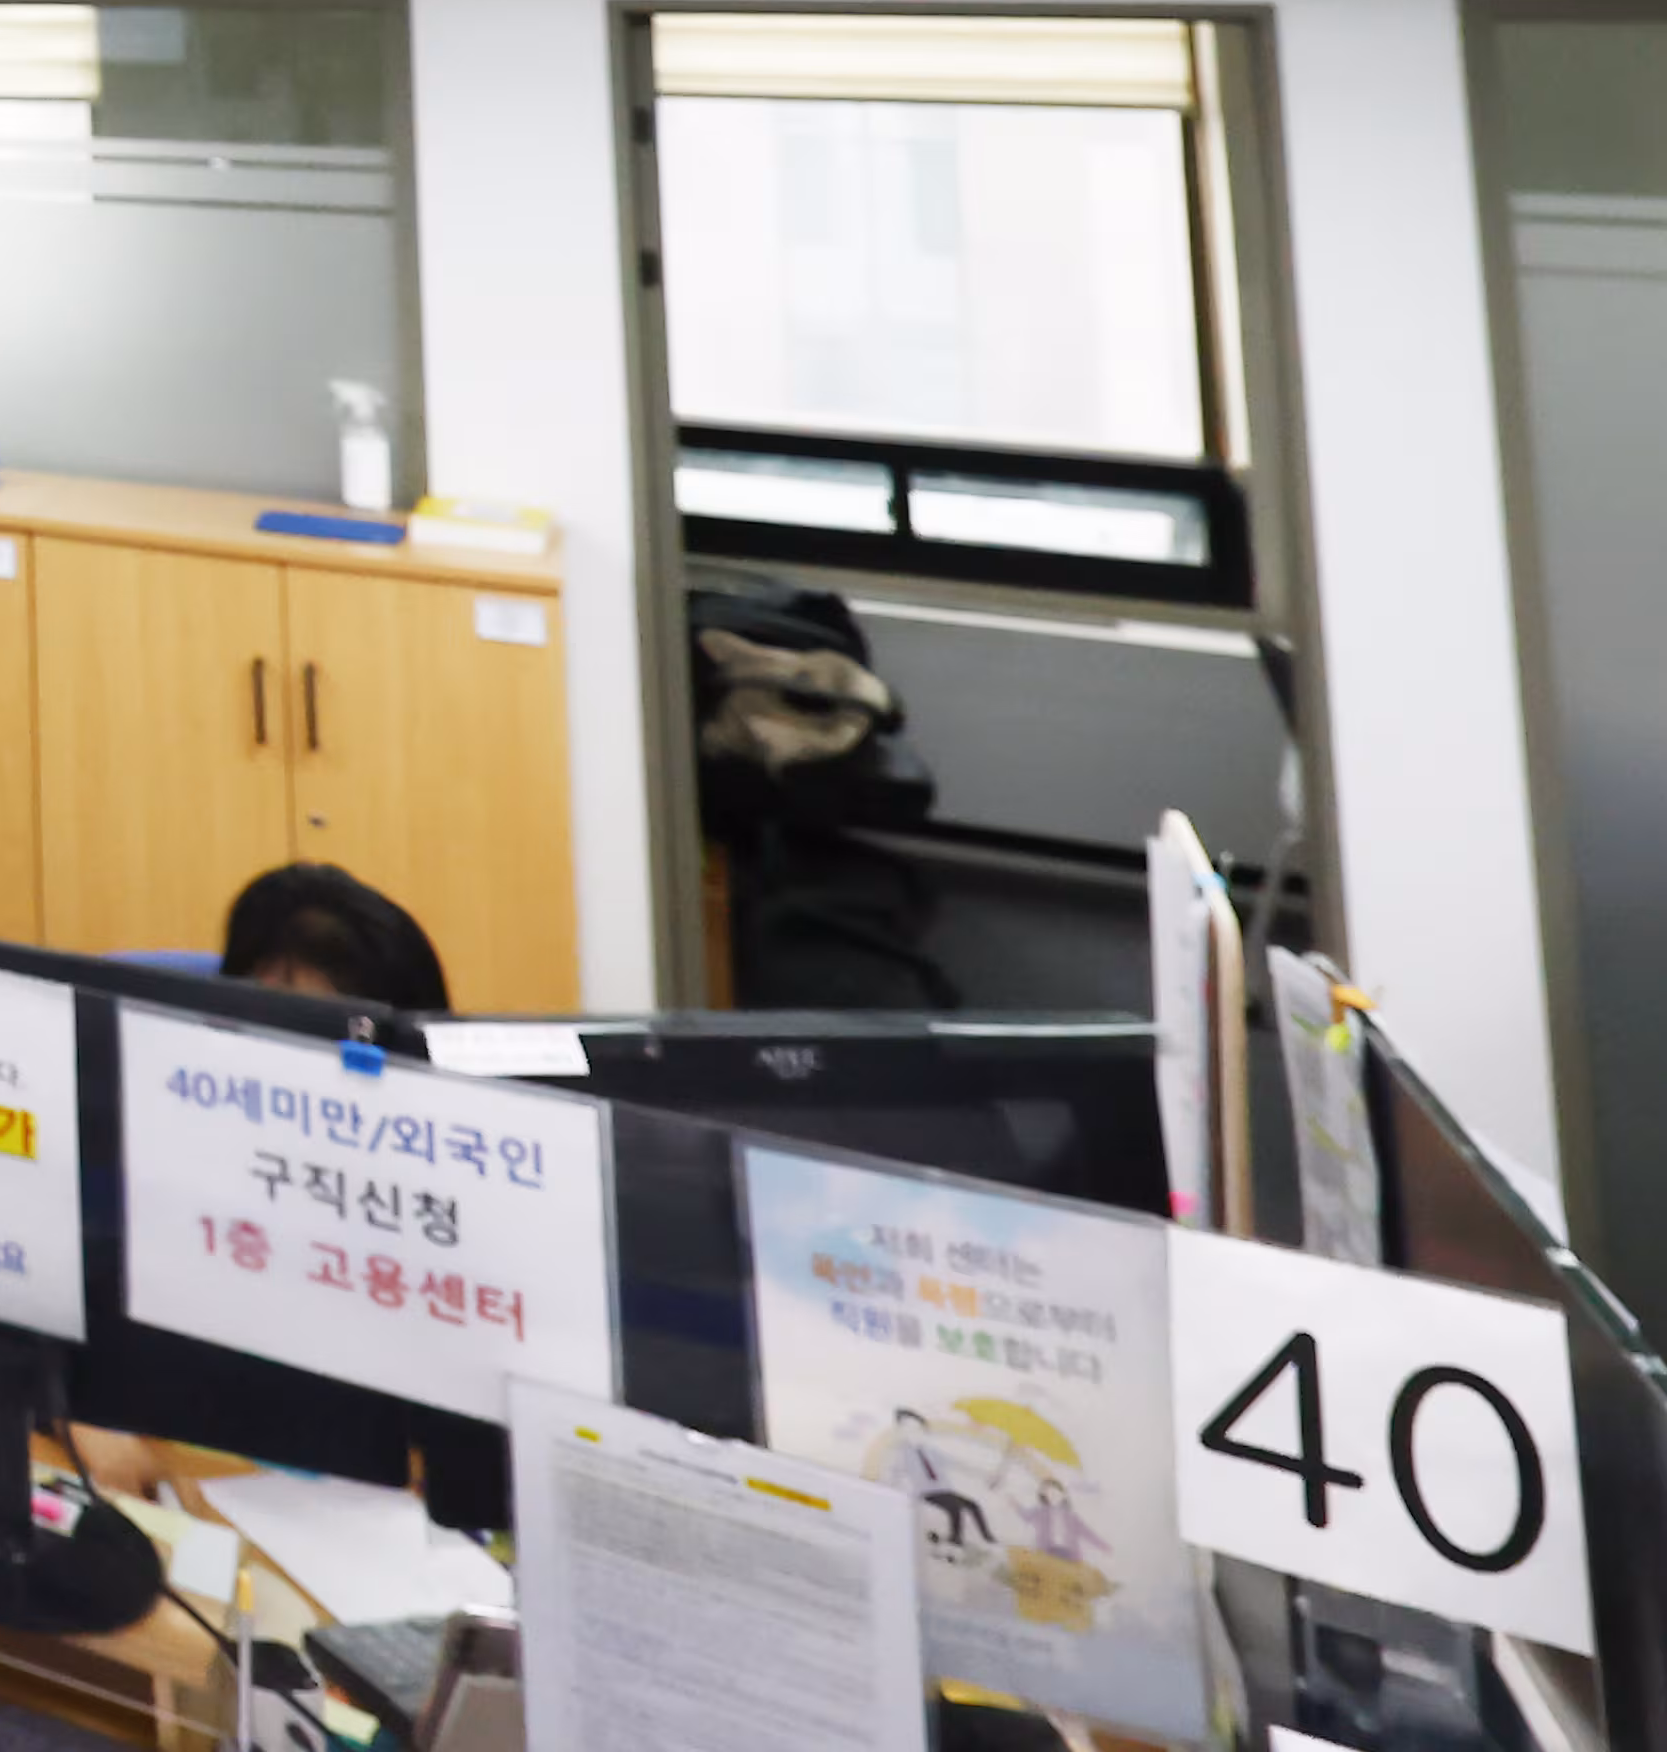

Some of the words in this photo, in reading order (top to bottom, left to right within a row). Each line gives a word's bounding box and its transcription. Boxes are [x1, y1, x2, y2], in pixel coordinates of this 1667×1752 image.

[166, 1066, 546, 1191] 40세미만/외국인
[251, 1150, 461, 1247] 구직신청
[198, 1215, 273, 1272] 1층
[306, 1240, 527, 1342] 고용센터
[1198, 1328, 1547, 1575] 40
